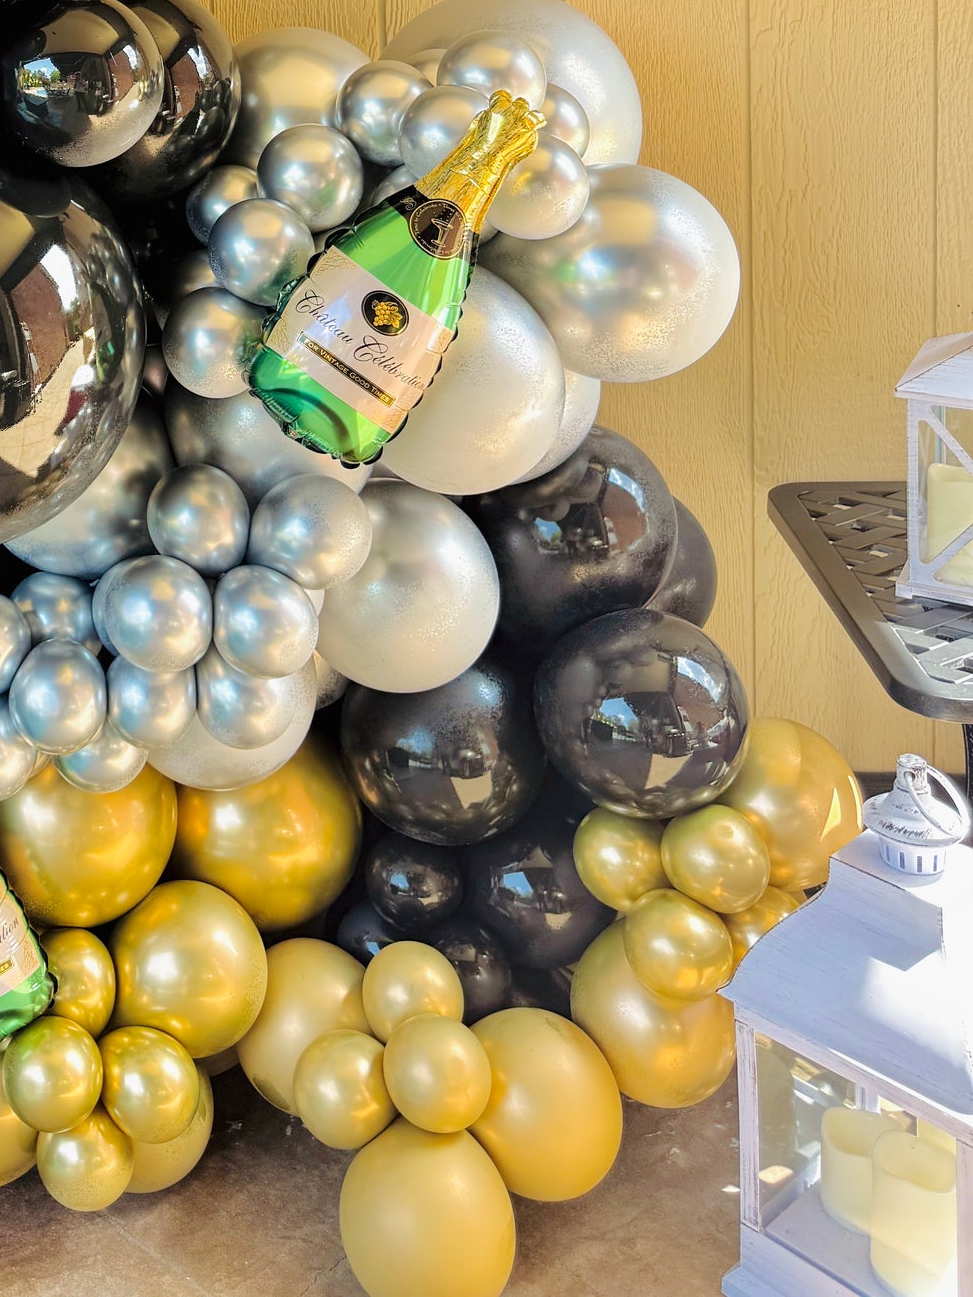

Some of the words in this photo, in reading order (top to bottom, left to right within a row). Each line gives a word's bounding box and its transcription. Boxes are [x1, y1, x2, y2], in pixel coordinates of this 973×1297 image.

[295, 289, 354, 345] Château
[353, 334, 425, 391] Célébration
[304, 338, 319, 353] FOR
[320, 346, 350, 374] VINTAGE
[349, 369, 370, 389] GOOD
[371, 386, 391, 403] TIMES
